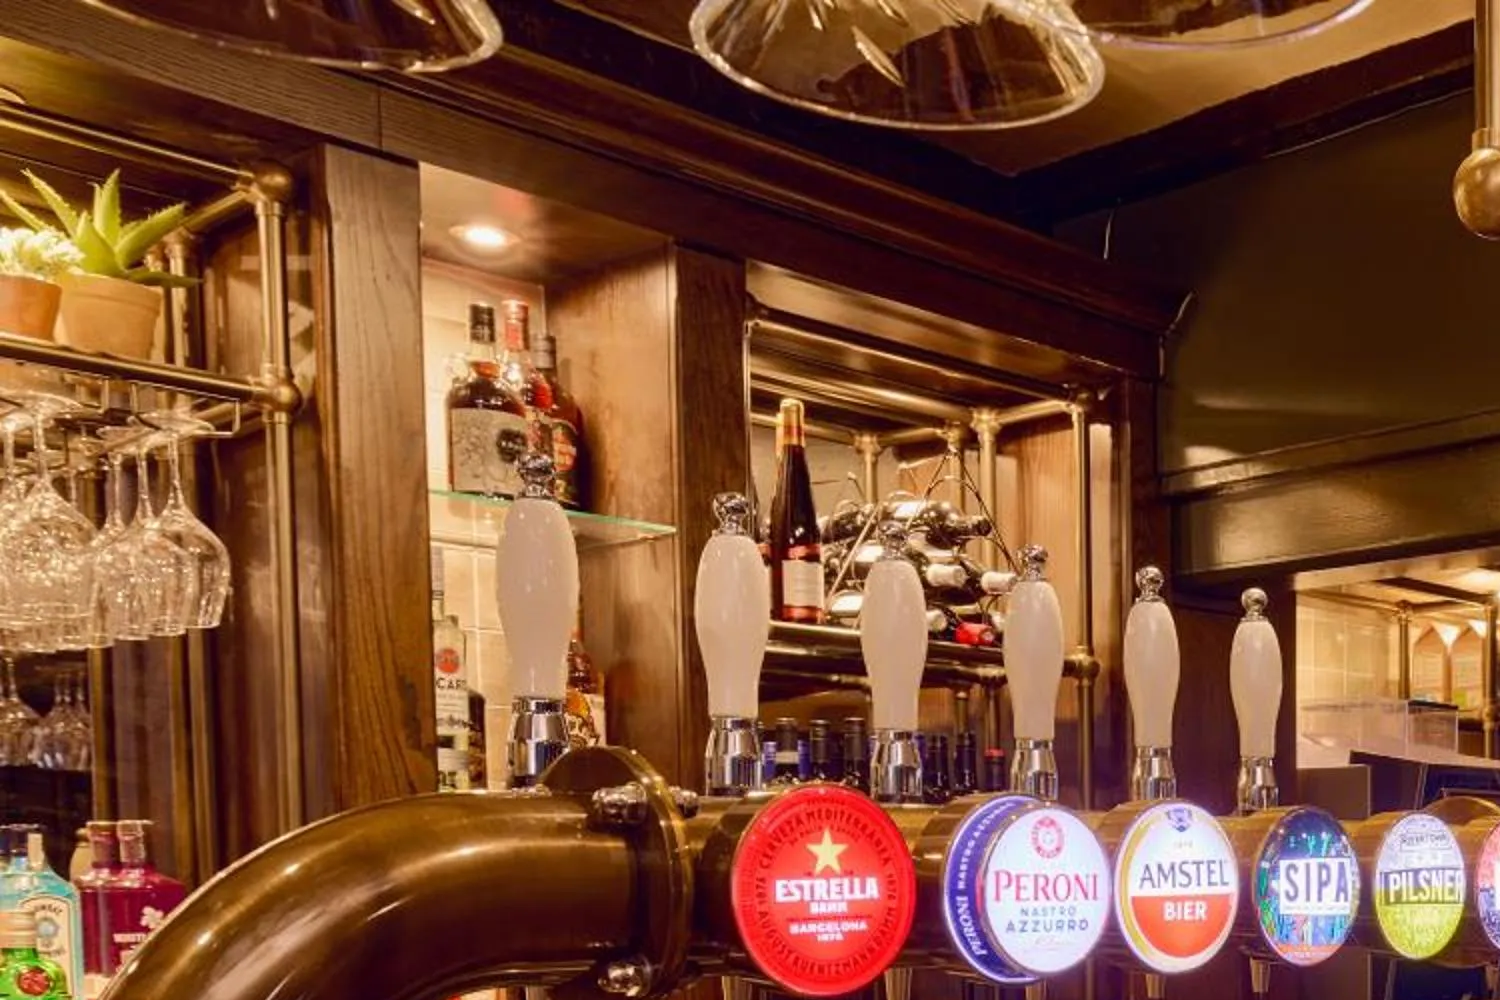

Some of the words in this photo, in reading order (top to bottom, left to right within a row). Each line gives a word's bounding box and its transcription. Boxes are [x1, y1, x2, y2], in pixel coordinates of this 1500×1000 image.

[993, 870, 1099, 902] PERONI
[1138, 859, 1230, 890] AMSTEL
[1284, 862, 1350, 904] SIPA
[1388, 867, 1463, 904] PILSNER
[775, 878, 880, 902] ESTRELLA
[1019, 906, 1077, 918] NASTRO
[1163, 899, 1208, 921] BIER
[788, 920, 868, 935] BARCELONA
[956, 895, 989, 957] PERONI
[1006, 919, 1089, 934] AZZURRO
